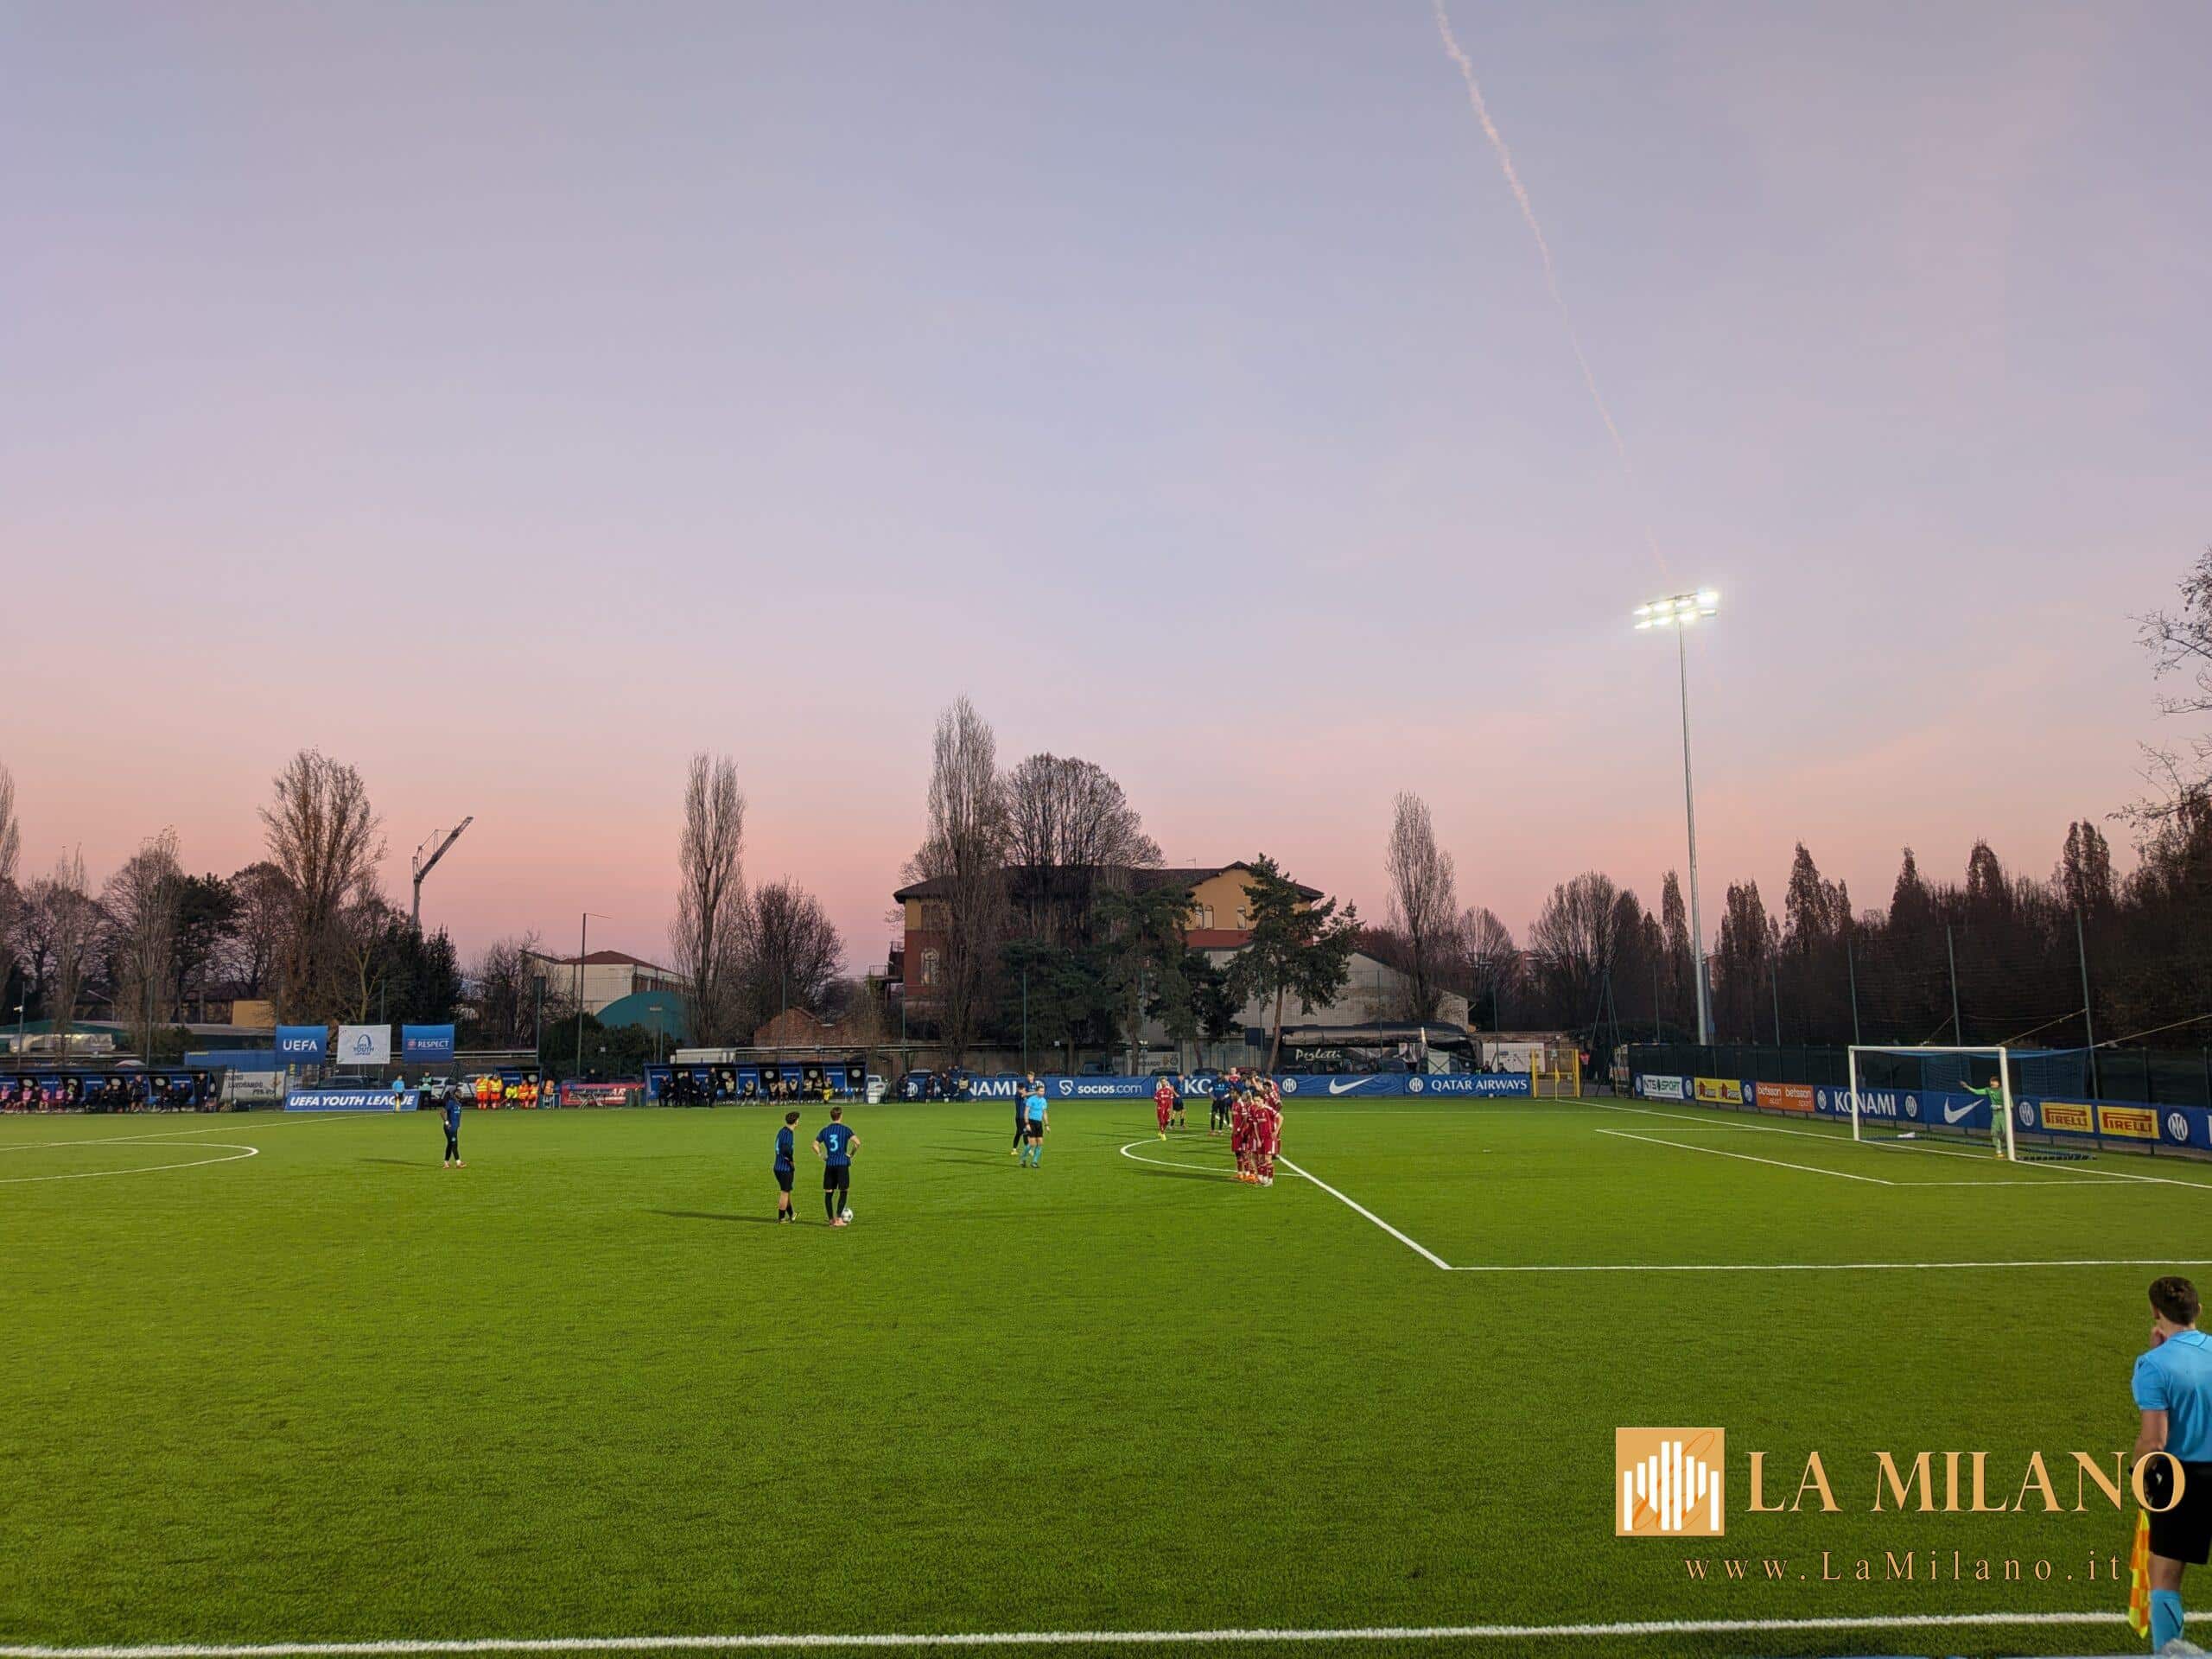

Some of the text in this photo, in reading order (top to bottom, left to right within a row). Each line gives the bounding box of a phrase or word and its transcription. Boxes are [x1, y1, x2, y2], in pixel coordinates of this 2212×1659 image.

[283, 1039, 318, 1051] UEFA
[1431, 1078, 1528, 1093] QATAR AIRWAYS
[1661, 1079, 1681, 1091] SPORT
[1785, 1086, 1812, 1098] betsson
[289, 1096, 320, 1107] UEFA
[321, 1096, 365, 1107] YOUTH
[1834, 1090, 1897, 1116] KONAMI
[2044, 1107, 2152, 1133] PIRELLI PIRELLI
[829, 1134, 839, 1152] 3
